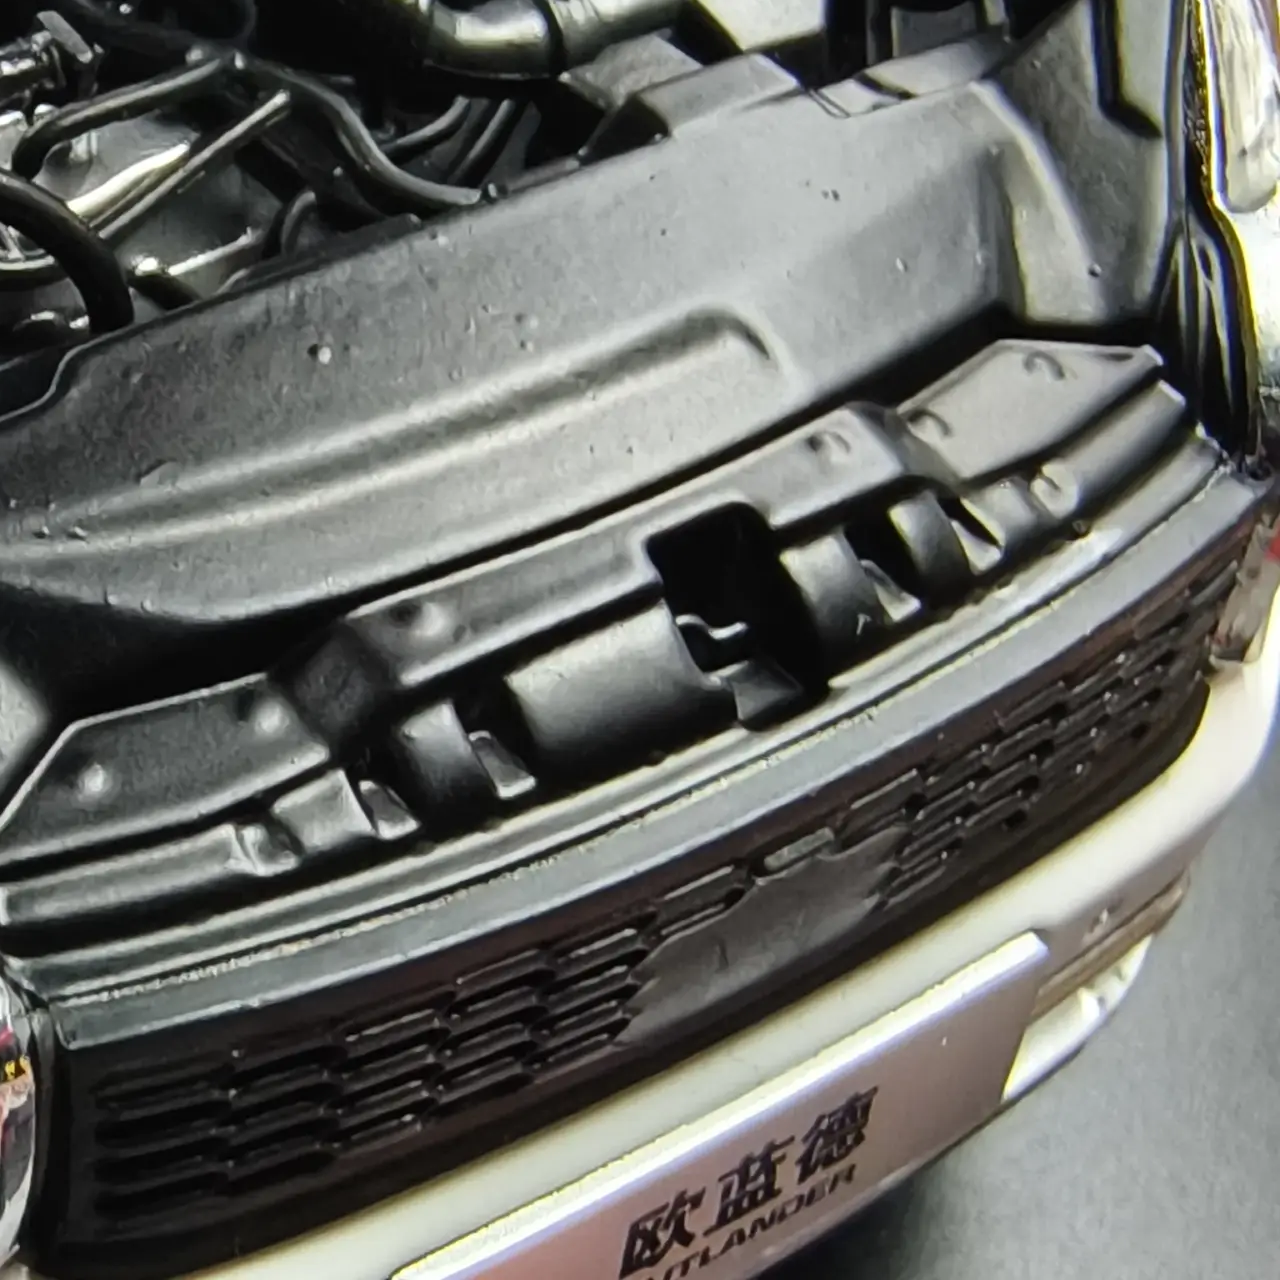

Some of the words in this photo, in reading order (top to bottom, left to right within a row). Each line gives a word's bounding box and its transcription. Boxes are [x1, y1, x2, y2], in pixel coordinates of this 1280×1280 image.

[619, 1086, 878, 1279] 欧蓝德
[645, 1164, 856, 1280] TLANDER
